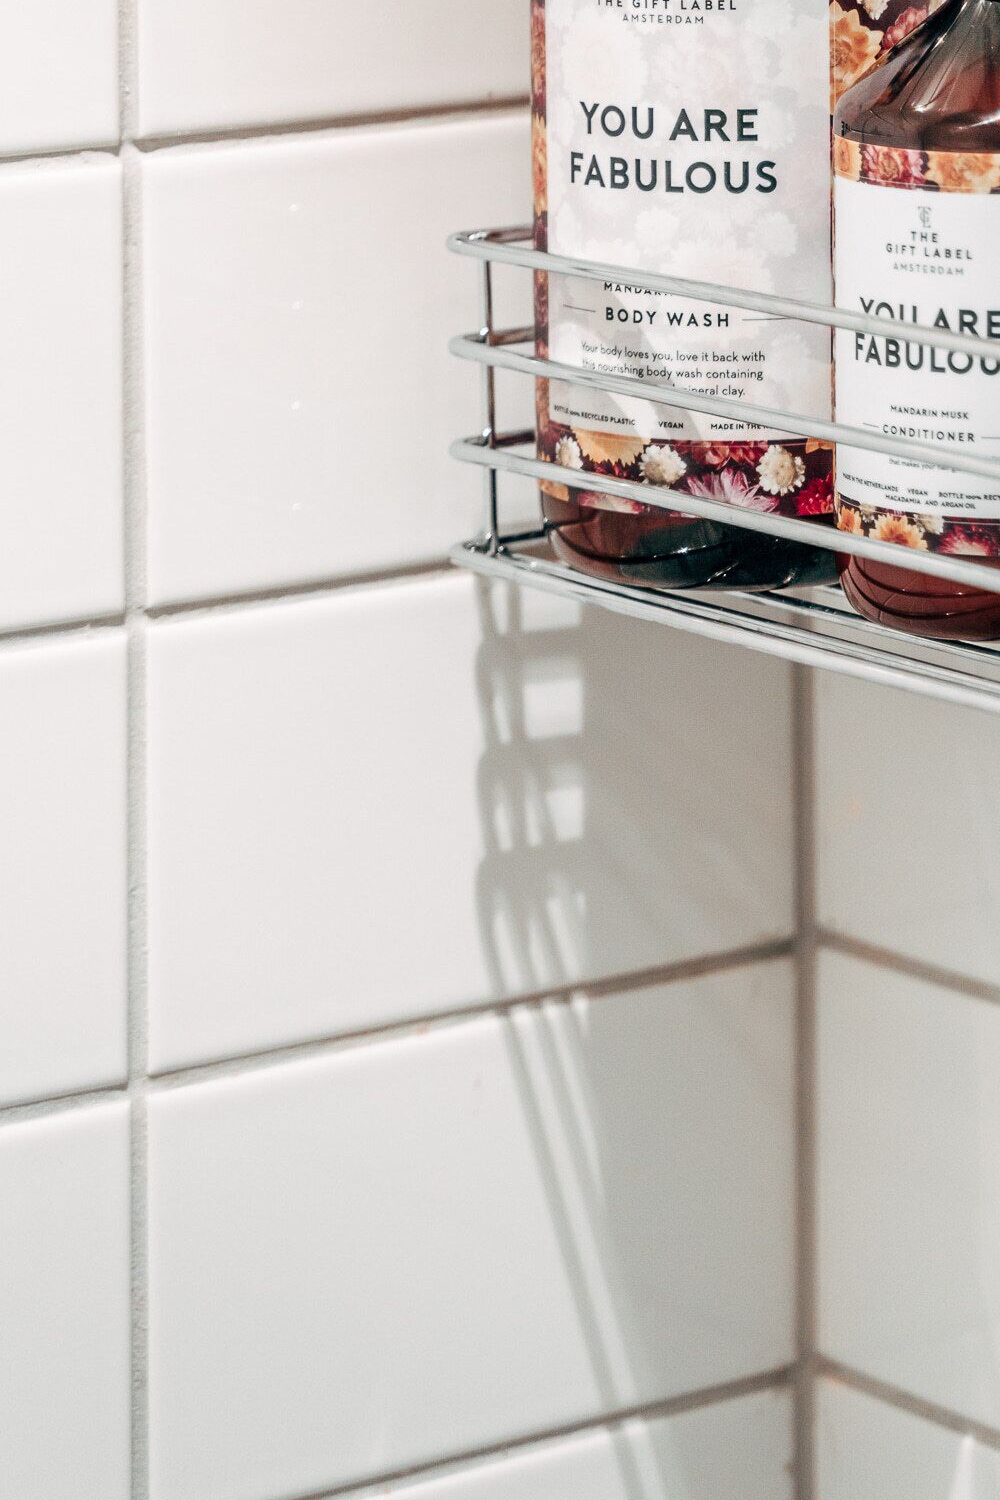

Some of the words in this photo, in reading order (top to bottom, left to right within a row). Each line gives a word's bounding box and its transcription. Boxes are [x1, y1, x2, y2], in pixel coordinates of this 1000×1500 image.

[680, 0, 738, 11] LABEL
[622, 13, 705, 25] AMSTERDAM
[579, 101, 654, 140] YOU
[668, 108, 759, 142] ARE
[570, 151, 778, 194] FABULOUS
[911, 231, 939, 243] THE
[886, 243, 916, 256] GIFT
[924, 248, 974, 260] LABEL
[893, 263, 964, 276] AMSTERDAM
[605, 307, 657, 325] BODY
[667, 311, 730, 327] WASH
[581, 341, 598, 354] Your
[600, 344, 622, 359] body
[624, 346, 649, 359] loves
[676, 350, 698, 361] love
[701, 351, 709, 361] it
[712, 351, 739, 362] back
[741, 350, 766, 362] with
[598, 363, 644, 378] nourishing
[646, 366, 672, 380] body
[676, 368, 702, 378] wash
[706, 369, 764, 381] containing
[721, 385, 746, 398] clay.
[581, 411, 609, 422] RECYCLED
[609, 416, 636, 426] PLASTIC
[890, 405, 938, 417] MANDARIN
[941, 411, 969, 420] MUSK
[658, 421, 684, 429] VEGAN
[882, 424, 976, 442] CONDITIONER
[863, 480, 898, 492] NETHERLANDS
[907, 488, 929, 496] VEGAN
[885, 494, 921, 504] MACADAMIA
[925, 499, 938, 507] AND
[941, 501, 964, 509] ARGAN
[965, 502, 976, 510] OIL
[938, 491, 964, 499] BOTTLE
